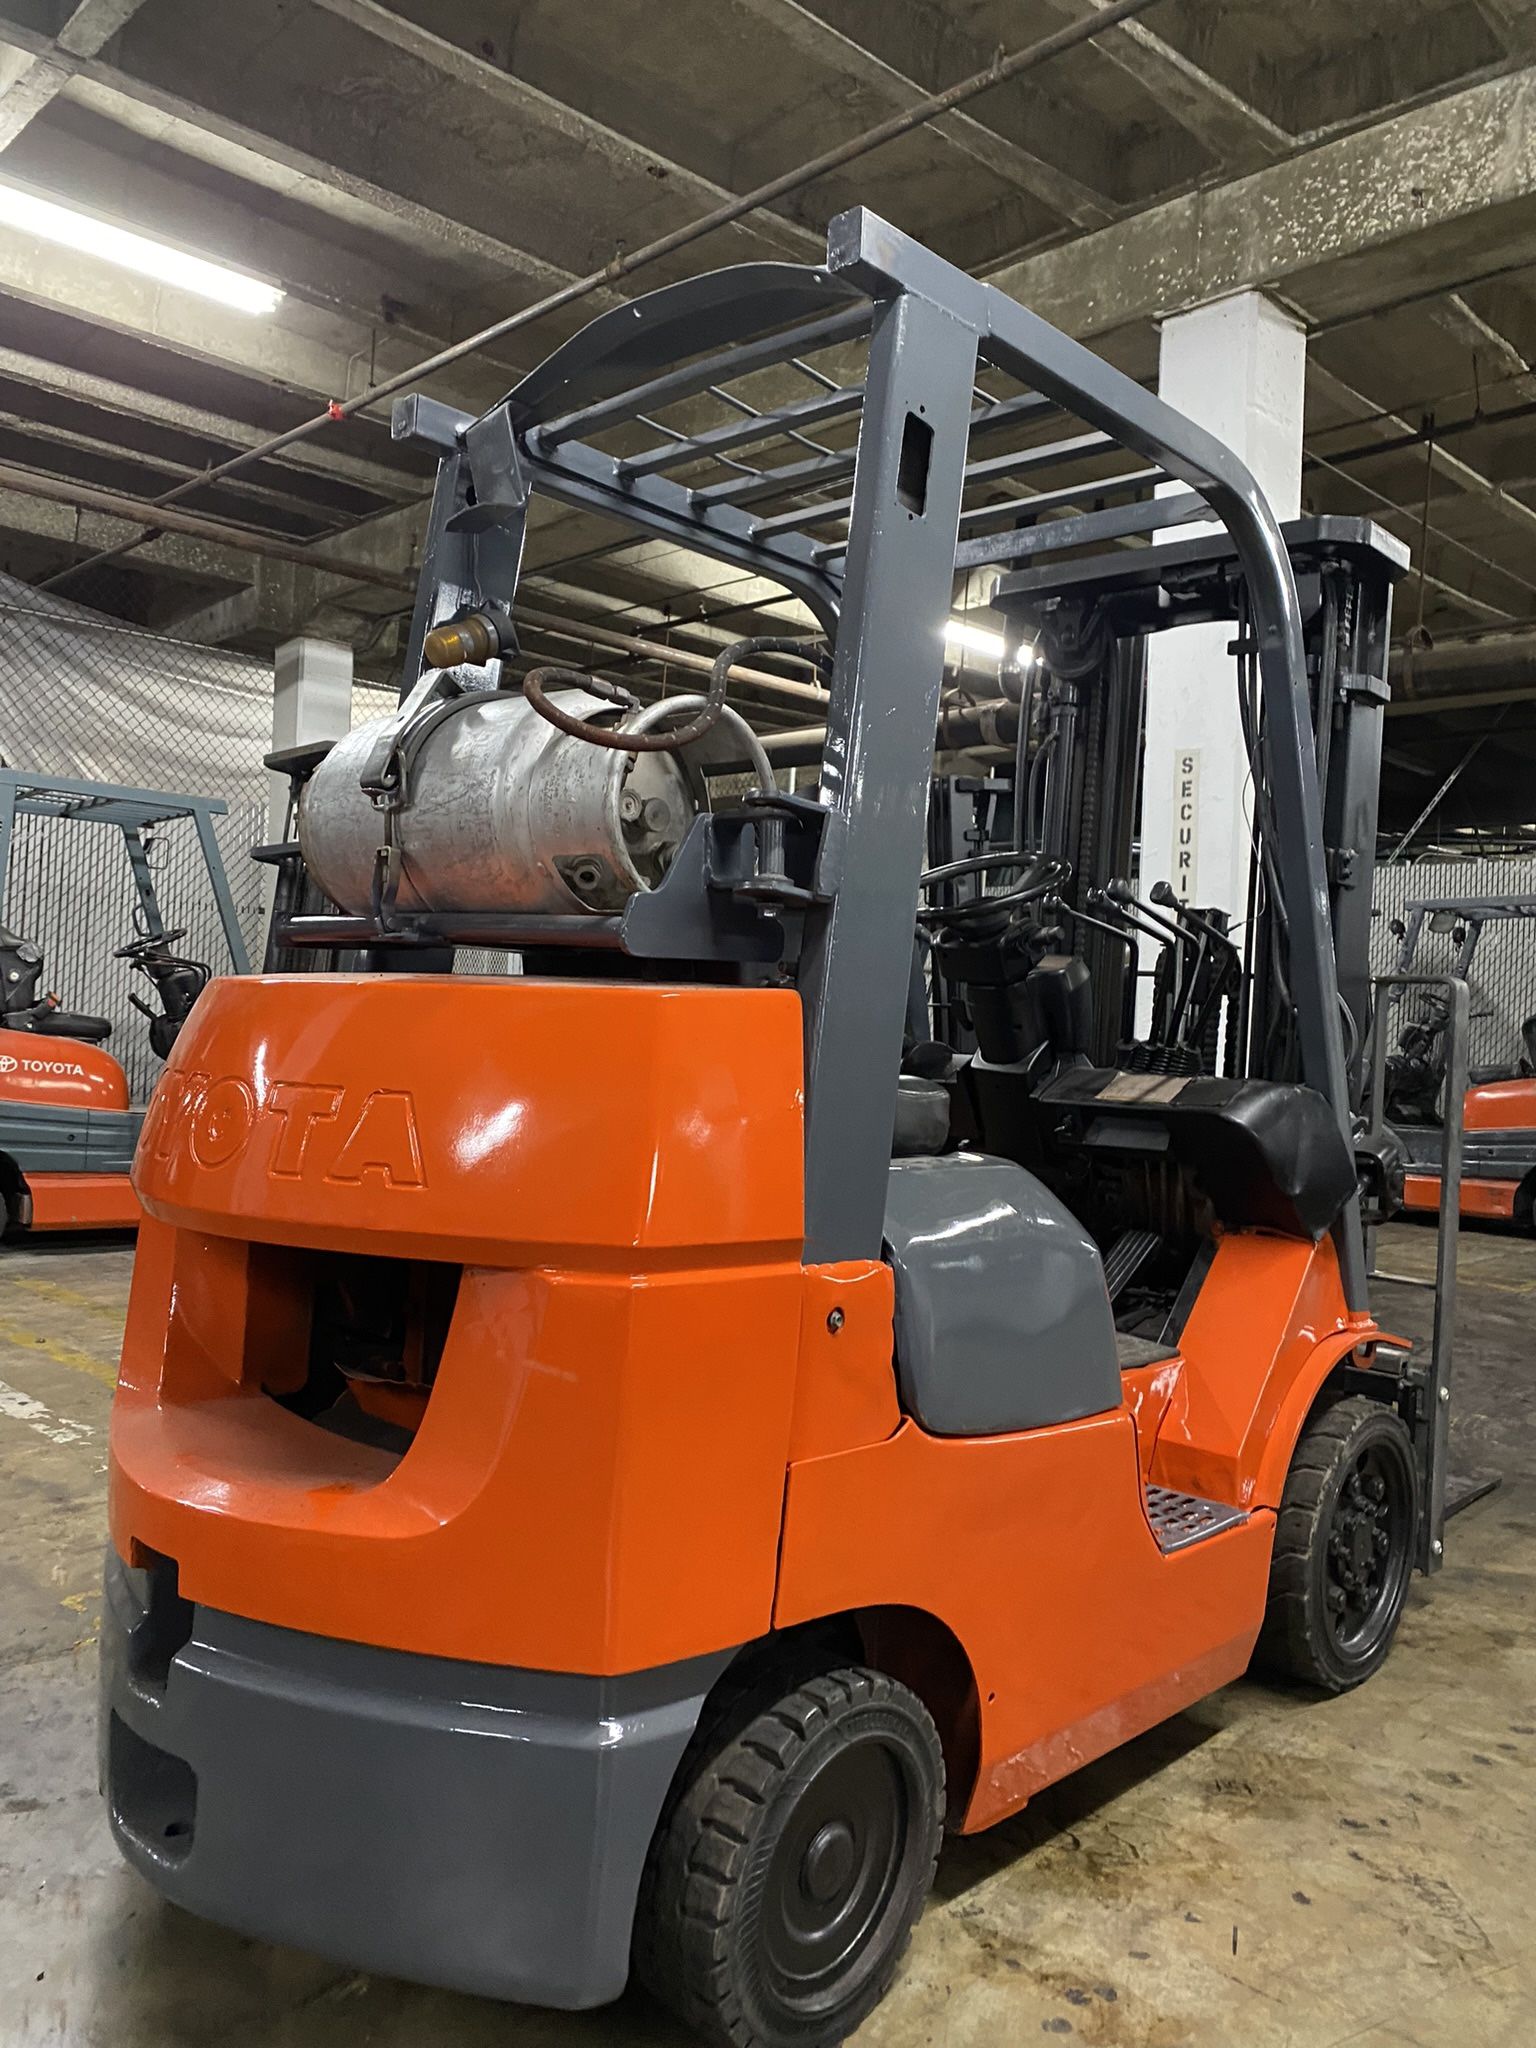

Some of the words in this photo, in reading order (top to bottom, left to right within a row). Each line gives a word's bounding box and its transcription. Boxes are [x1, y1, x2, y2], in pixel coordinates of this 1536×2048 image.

[1178, 756, 1194, 909] SECURIT
[21, 1059, 84, 1076] TOYOTA
[143, 1068, 428, 1189] YOTA
